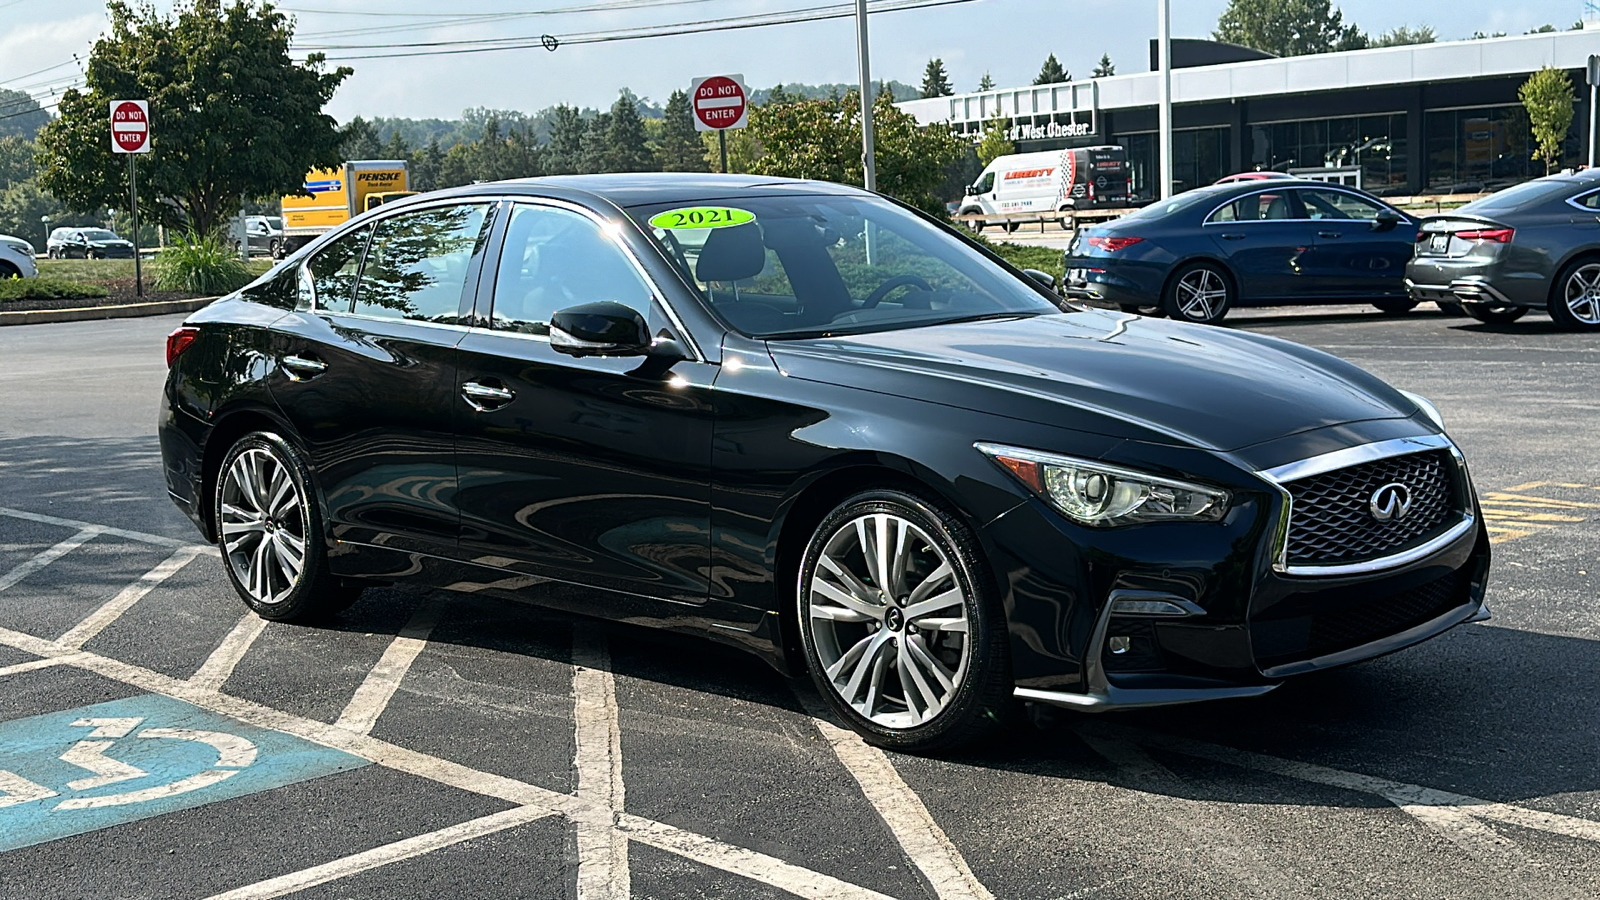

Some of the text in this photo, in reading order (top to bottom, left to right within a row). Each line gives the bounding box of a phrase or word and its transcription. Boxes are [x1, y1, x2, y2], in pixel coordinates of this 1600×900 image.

[700, 84, 737, 97] DO NOT
[115, 111, 142, 120] DO NOT
[705, 109, 736, 120] ENTER
[1010, 125, 1020, 141] of
[1021, 124, 1046, 140] West
[1047, 121, 1090, 138] Chester
[119, 133, 141, 142] ENTER
[357, 172, 401, 182] PENSKE
[1004, 167, 1056, 180] LIBERTY
[671, 209, 735, 227] 2021
